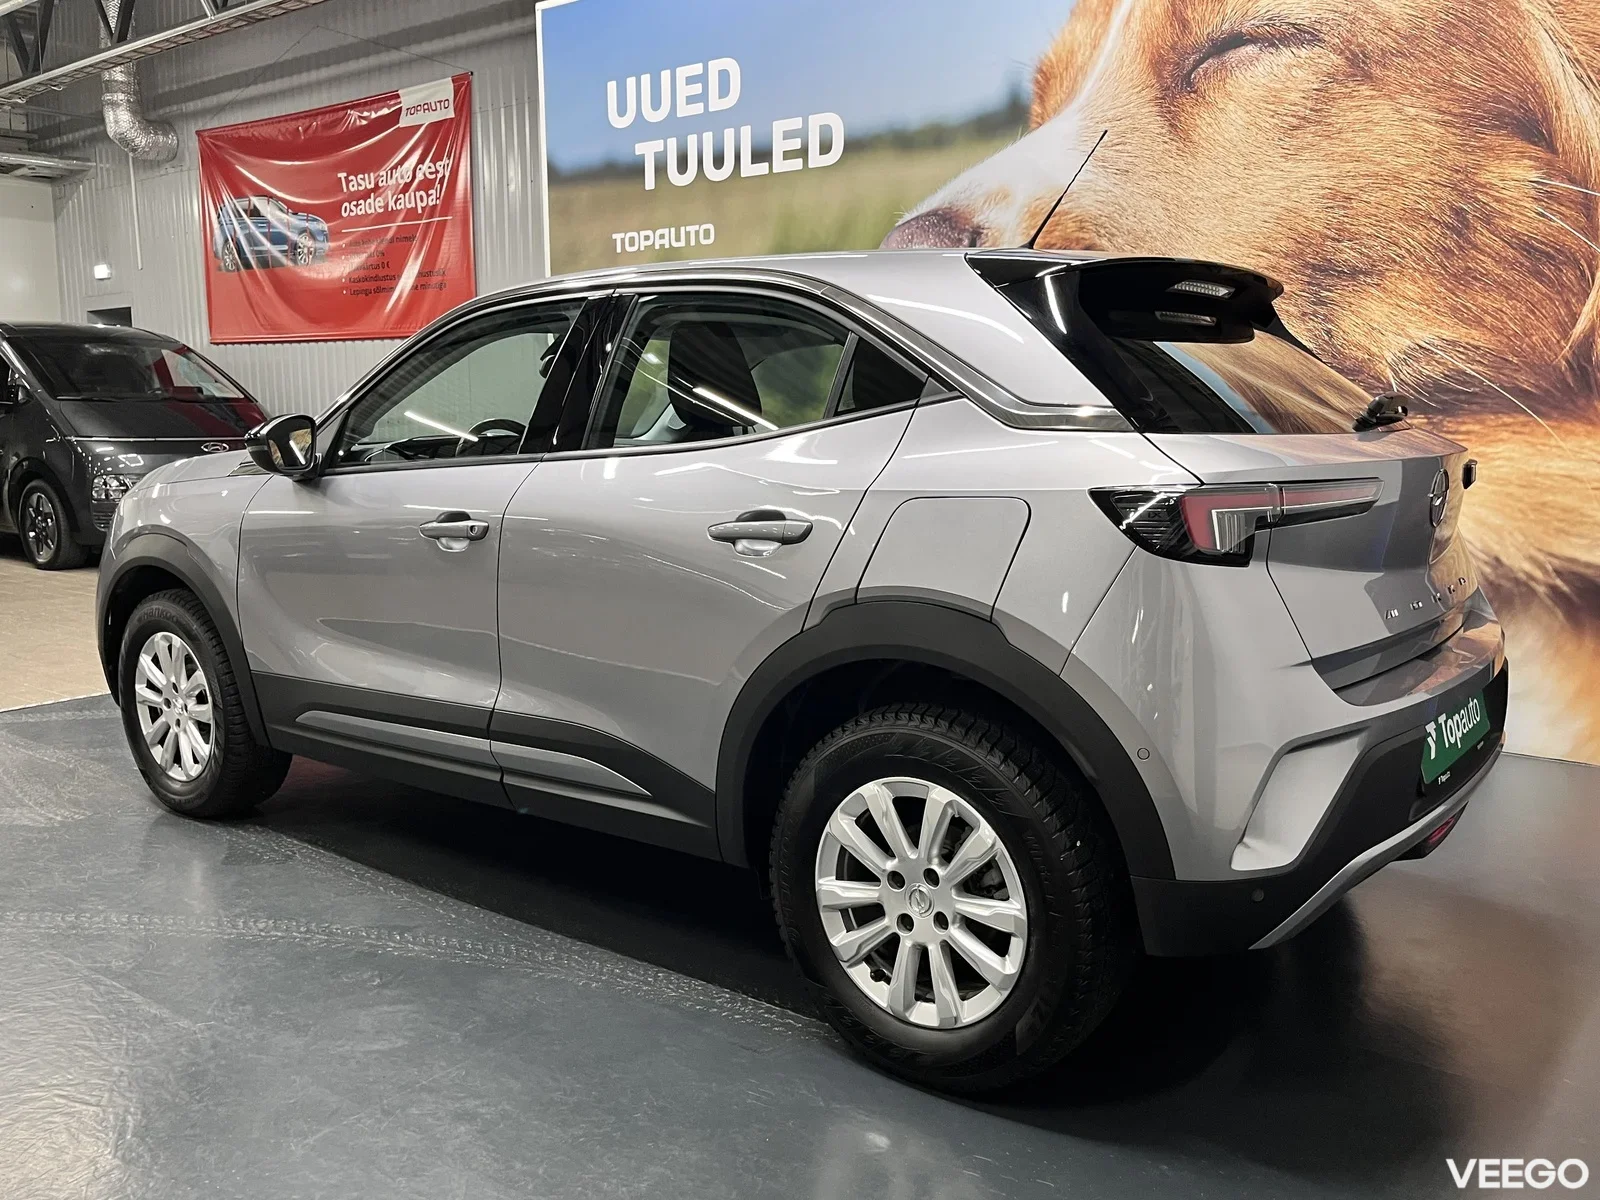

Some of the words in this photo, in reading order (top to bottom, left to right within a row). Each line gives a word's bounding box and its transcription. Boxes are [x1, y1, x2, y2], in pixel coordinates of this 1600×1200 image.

[404, 98, 450, 117] TOPAUTO
[606, 57, 741, 129] UUED
[634, 112, 845, 191] TUULED
[337, 172, 375, 192] Tasu
[378, 165, 413, 187] auto
[416, 158, 450, 181] eest
[341, 192, 384, 217] osade
[388, 184, 441, 214] kaupa!
[611, 223, 715, 253] TOPAUTO
[381, 261, 386, 269] 0
[386, 260, 391, 269] €
[1438, 697, 1481, 749] Topauto
